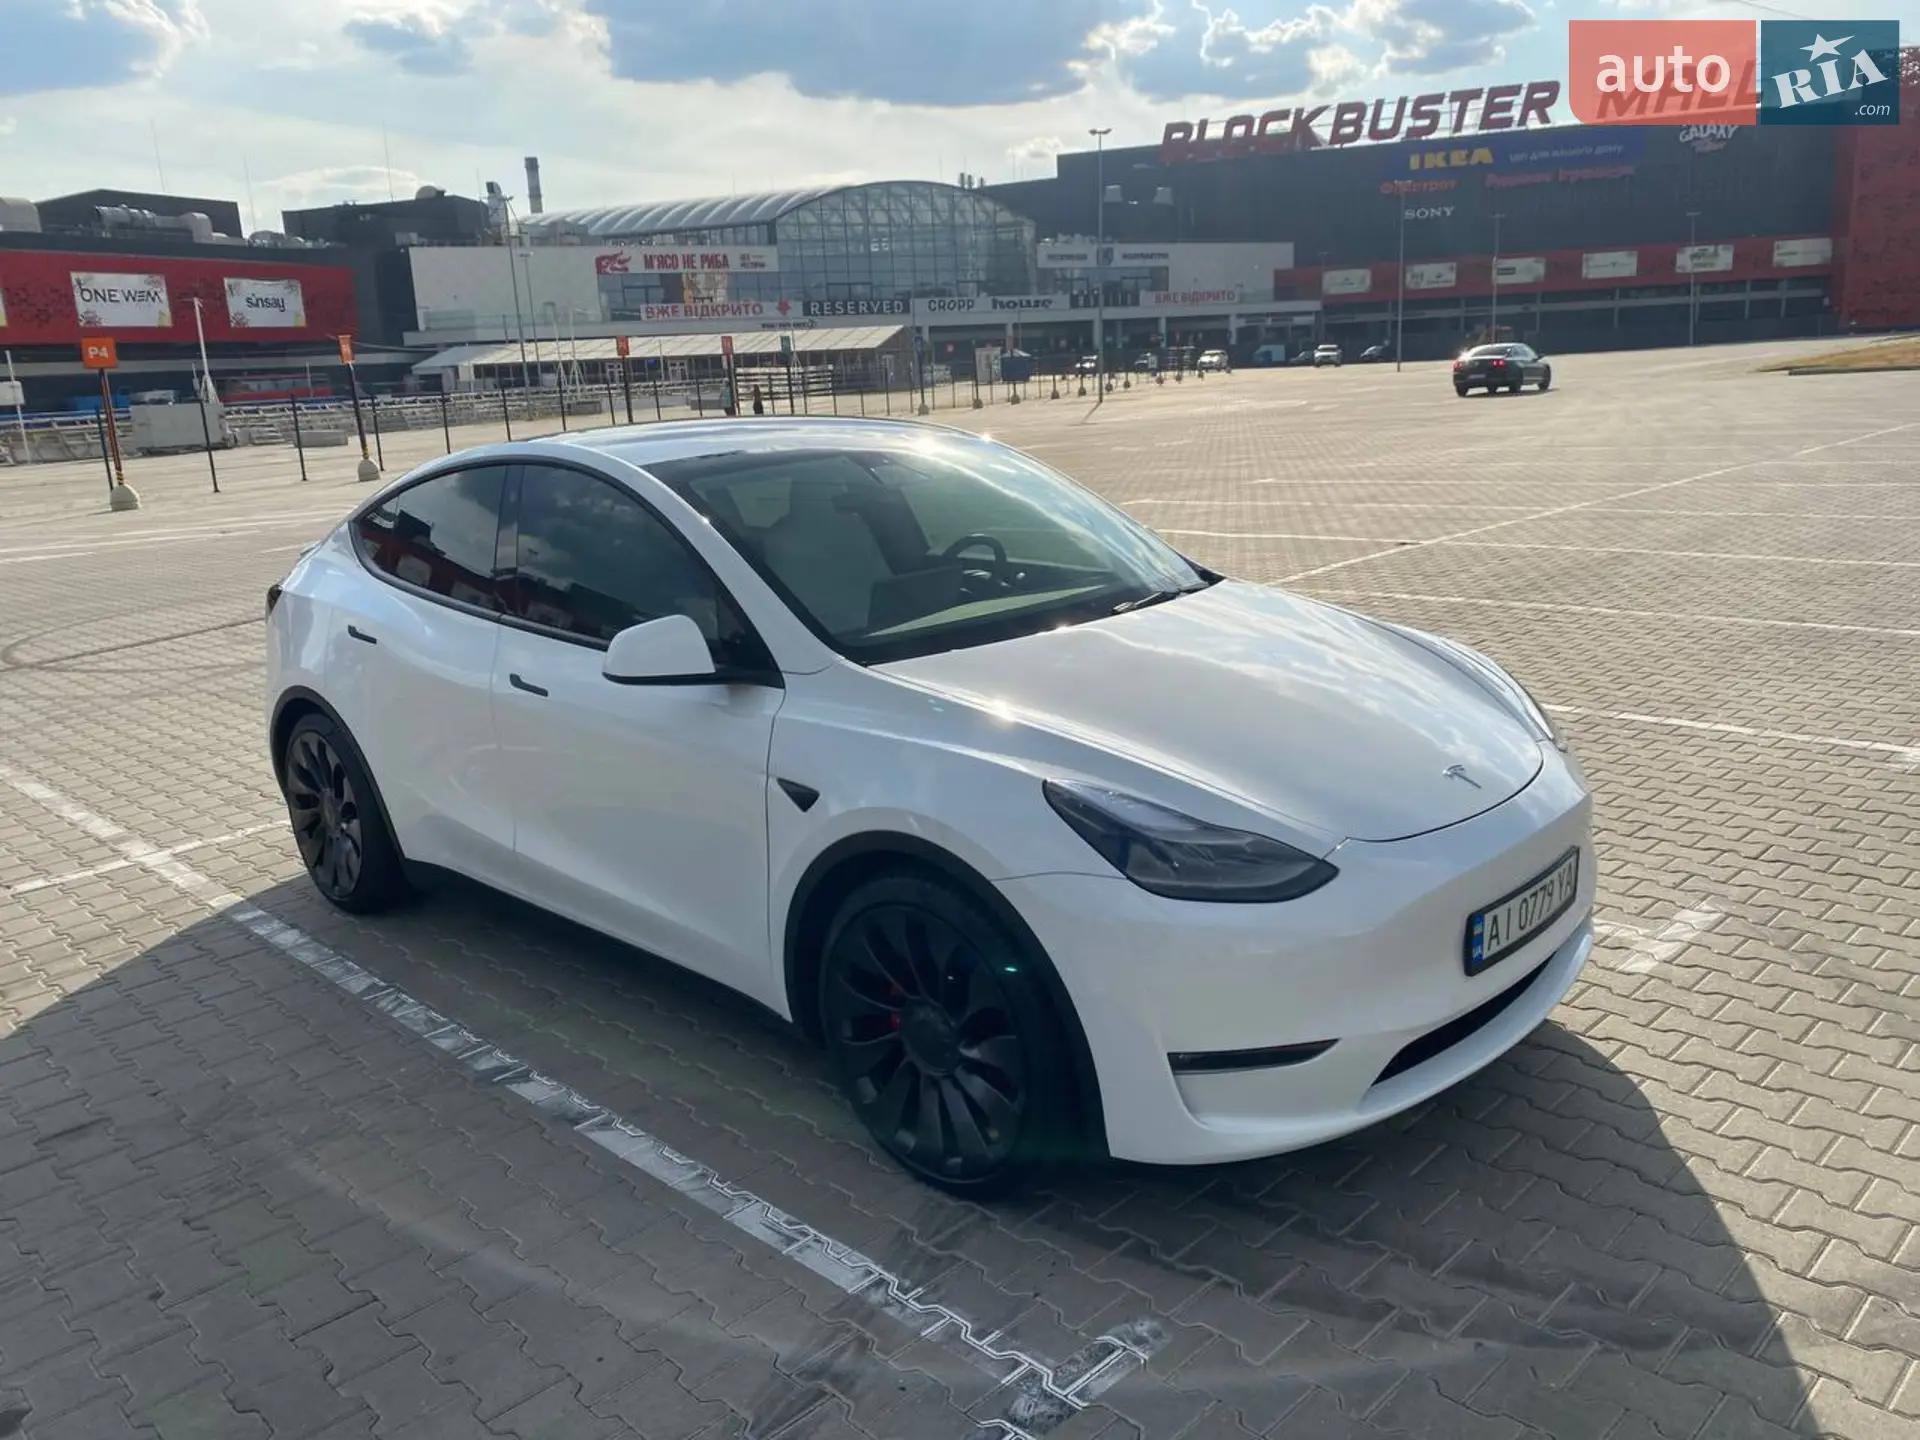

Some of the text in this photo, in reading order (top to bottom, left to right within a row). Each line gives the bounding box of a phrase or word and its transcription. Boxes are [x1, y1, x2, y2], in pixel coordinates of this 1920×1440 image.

[1157, 81, 1561, 164] BLOCKBUSTER
[1409, 146, 1494, 170] IKEA
[1404, 206, 1456, 220] SONY
[682, 253, 697, 269] НЕ
[700, 253, 730, 269] РИБА
[80, 287, 119, 303] ONE
[246, 293, 286, 313] sinsay
[684, 302, 764, 319] ВІДКРИТО
[810, 300, 904, 315] RESERVED
[927, 299, 975, 312] CROPP
[88, 346, 109, 359] P4
[1519, 879, 1554, 930] 0779
